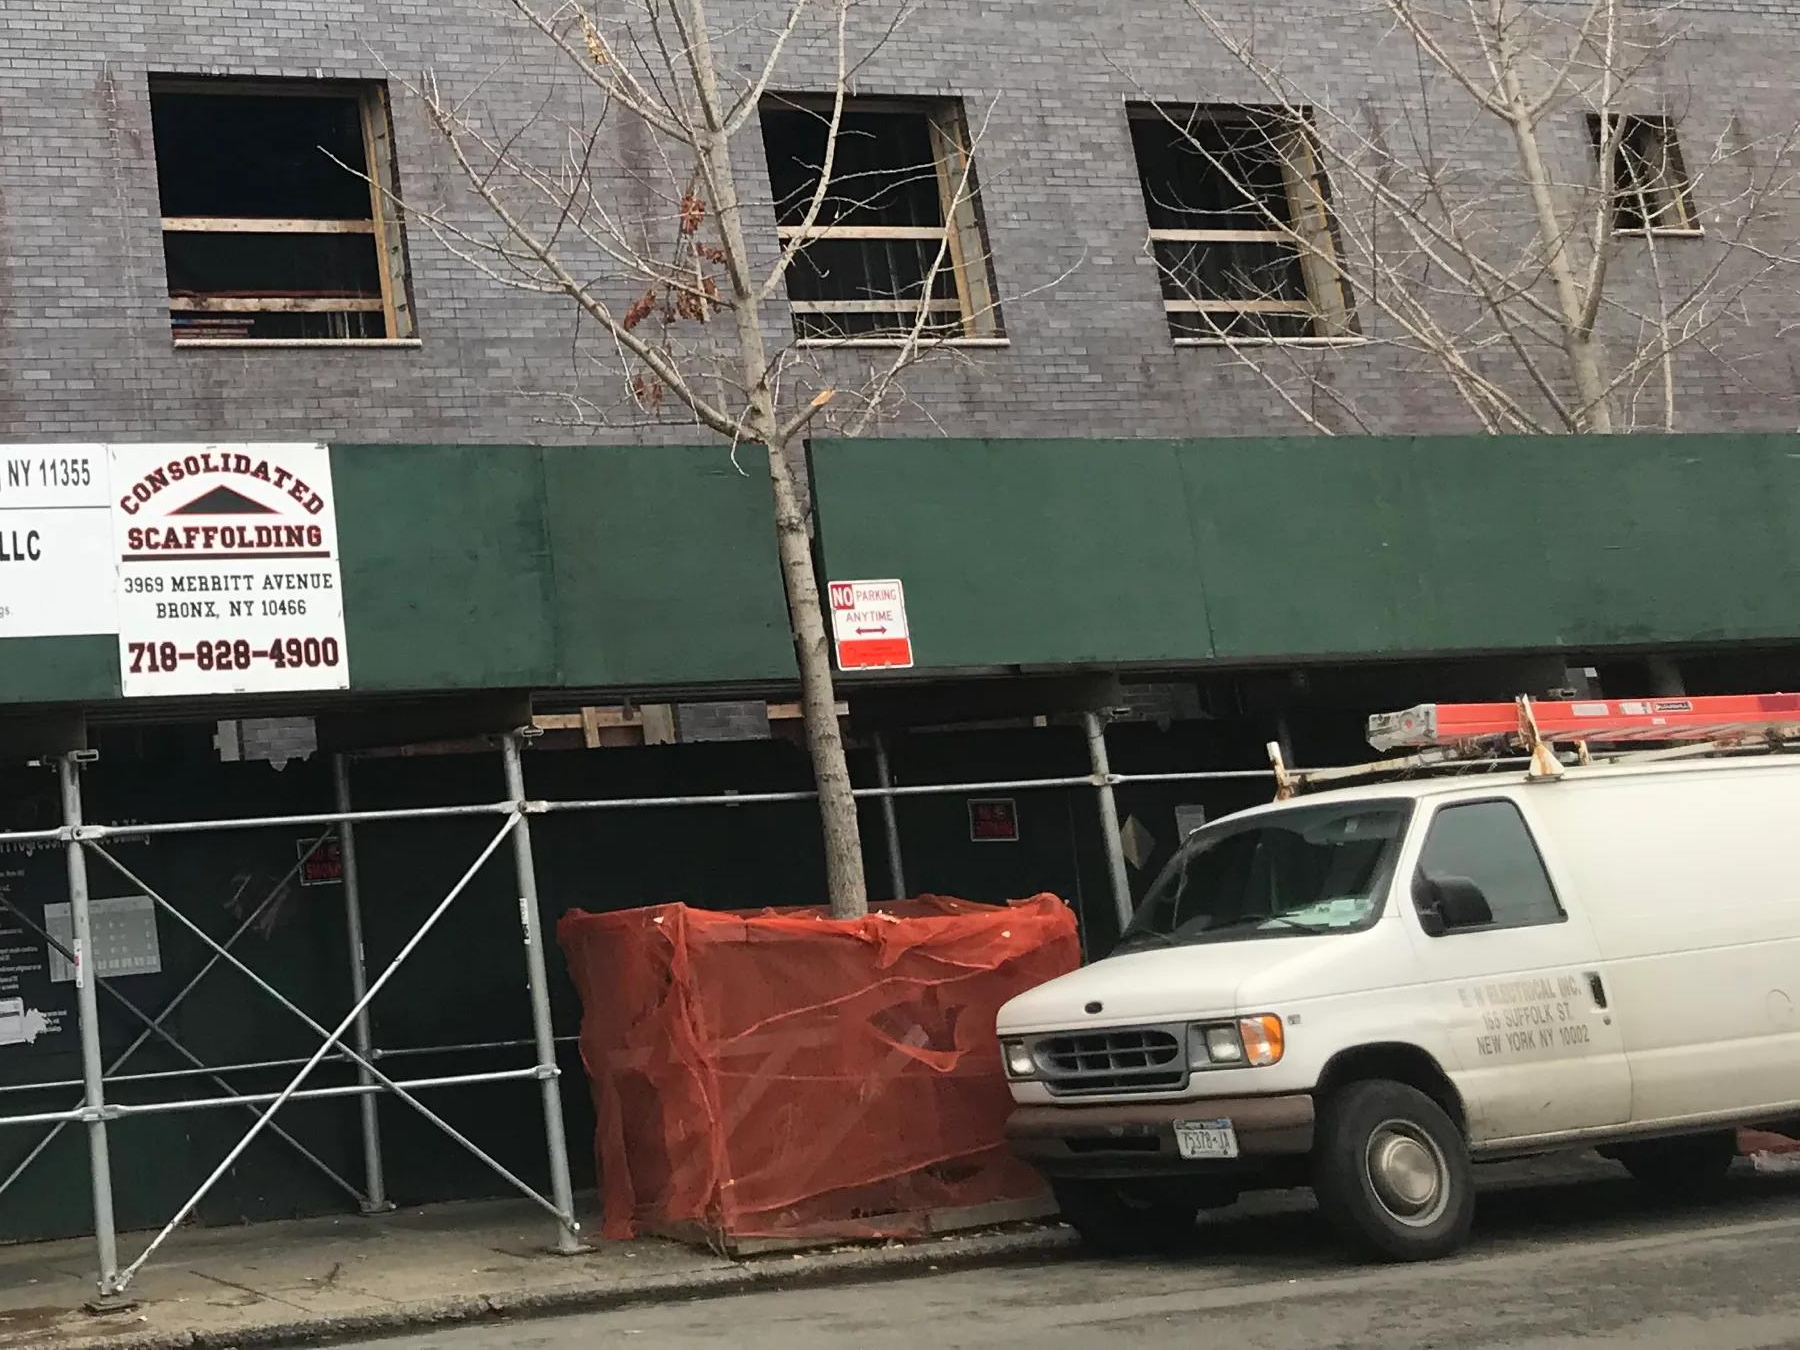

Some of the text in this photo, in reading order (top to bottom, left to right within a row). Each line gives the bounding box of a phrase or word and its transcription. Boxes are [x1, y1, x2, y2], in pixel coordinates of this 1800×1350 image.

[8, 459, 32, 487] NY
[39, 458, 91, 486] 11355
[120, 453, 324, 515] CONSOLIDATED
[128, 525, 322, 550] SCAFFOLDING
[124, 573, 333, 593] 3969 MERRITT AVENUE
[832, 587, 897, 607] NO PARKING
[156, 600, 307, 619] BRONX, NY 10466
[846, 610, 894, 622] ANYTIME
[128, 637, 339, 673] 718-828-4900
[1504, 1005, 1553, 1027] SUFFOLK
[1476, 1024, 1590, 1055] NEW YORK NY 10002
